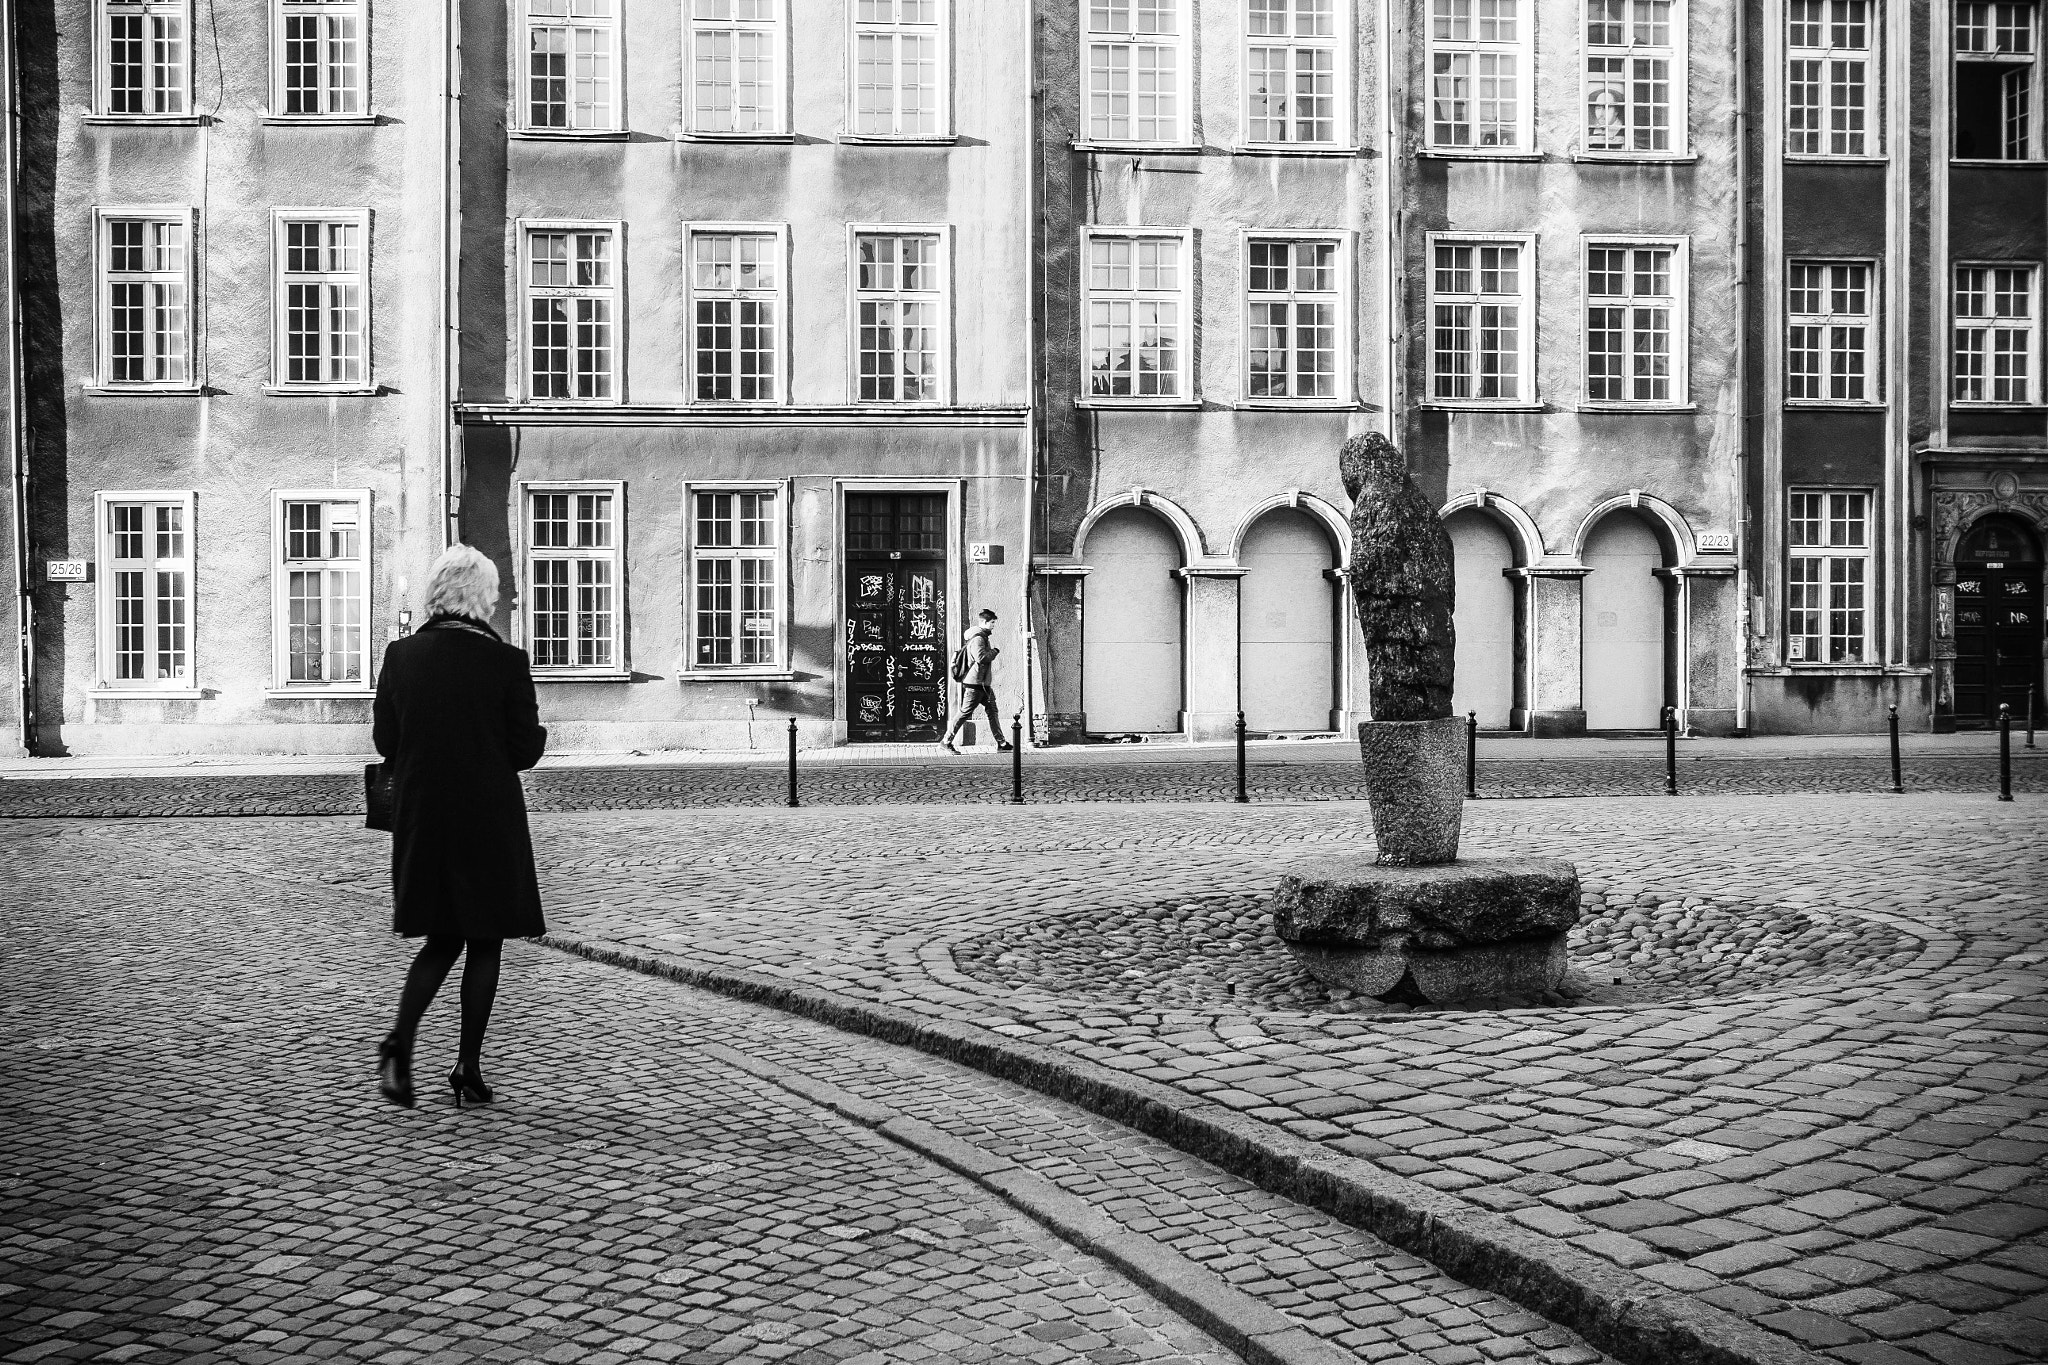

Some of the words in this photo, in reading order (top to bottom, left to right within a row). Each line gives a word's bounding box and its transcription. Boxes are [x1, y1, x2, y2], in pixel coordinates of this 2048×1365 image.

[1702, 535, 1729, 546] 22/23
[973, 545, 986, 557] 24
[51, 563, 82, 575] 25/26
